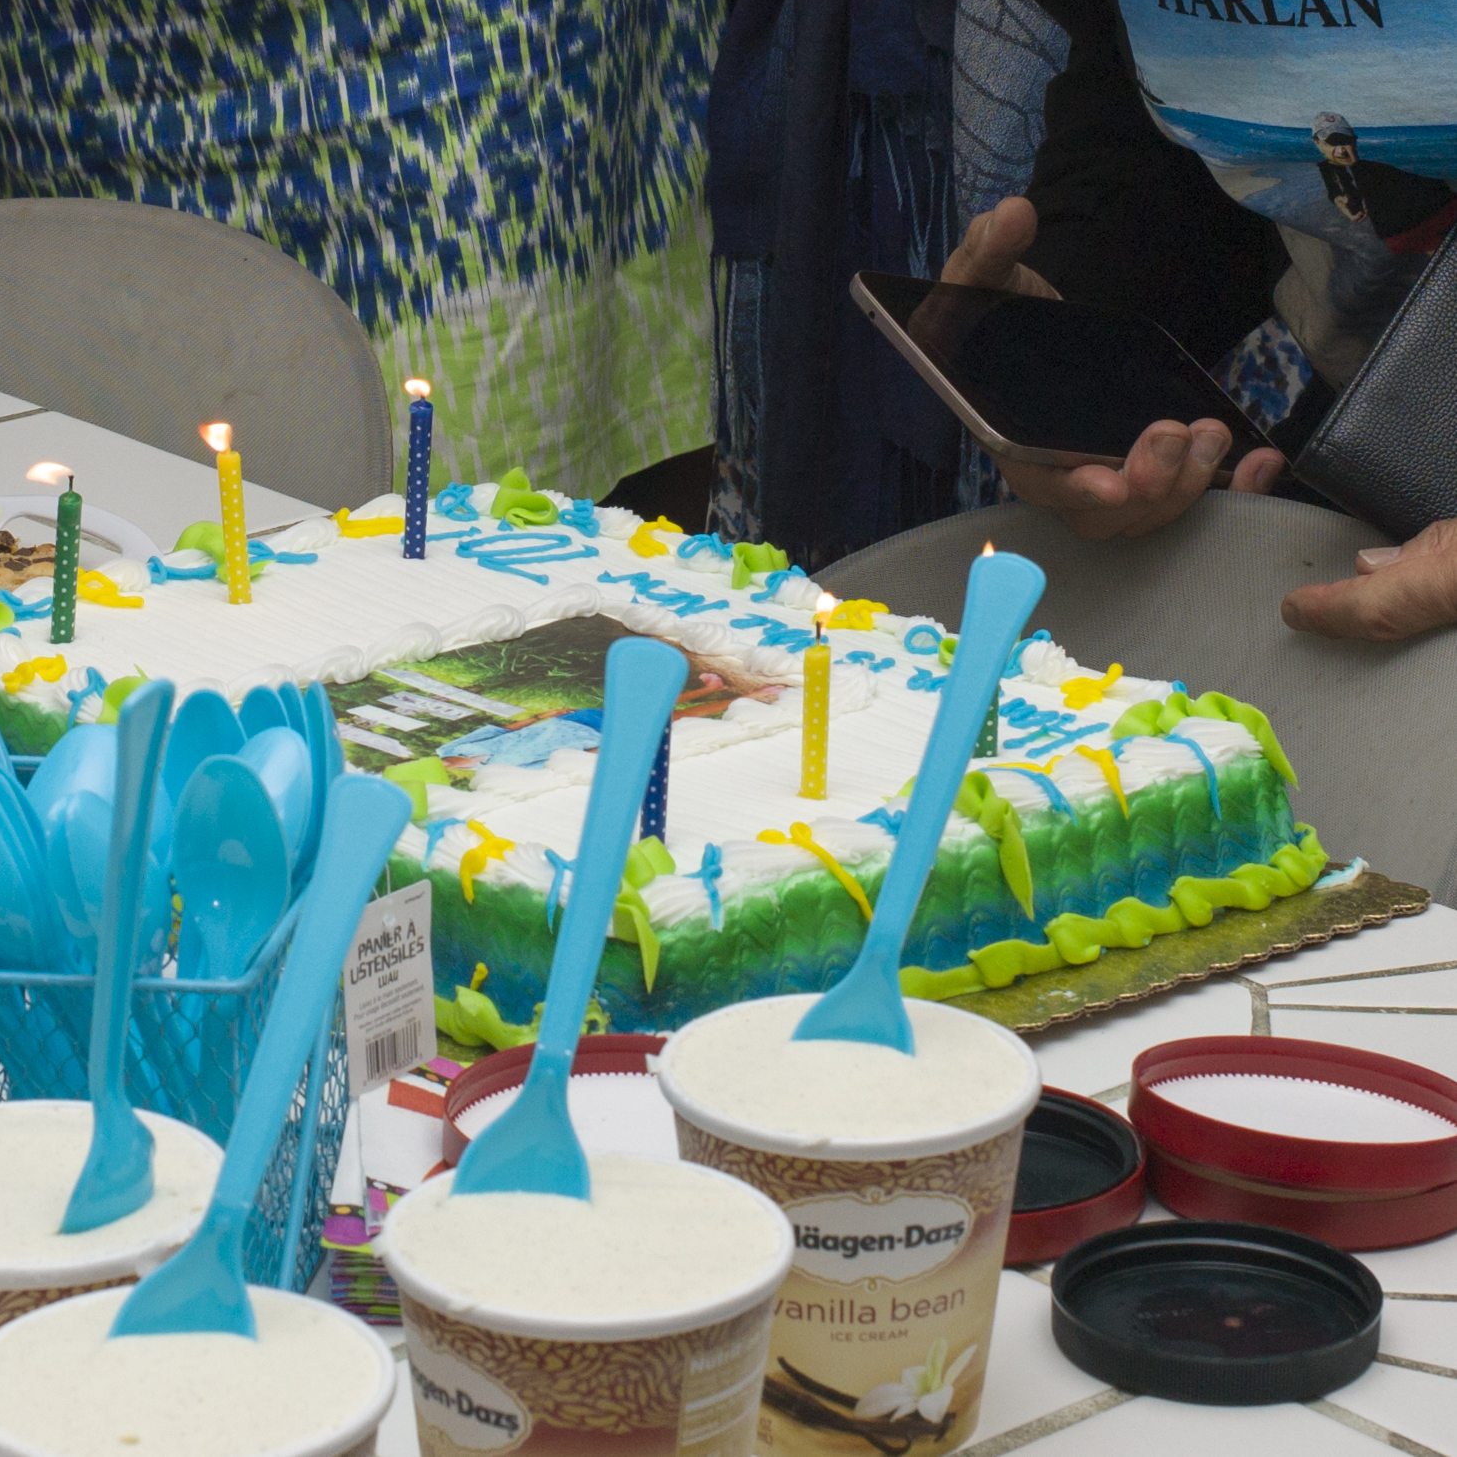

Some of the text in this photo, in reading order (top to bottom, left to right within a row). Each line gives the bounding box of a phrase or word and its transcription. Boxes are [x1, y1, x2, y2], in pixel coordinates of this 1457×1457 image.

[349, 935, 425, 985] USTENSILES
[357, 925, 402, 961] PANIER
[773, 1288, 966, 1326] vanilla bean
[830, 1328, 909, 1343] ICE CREAM
